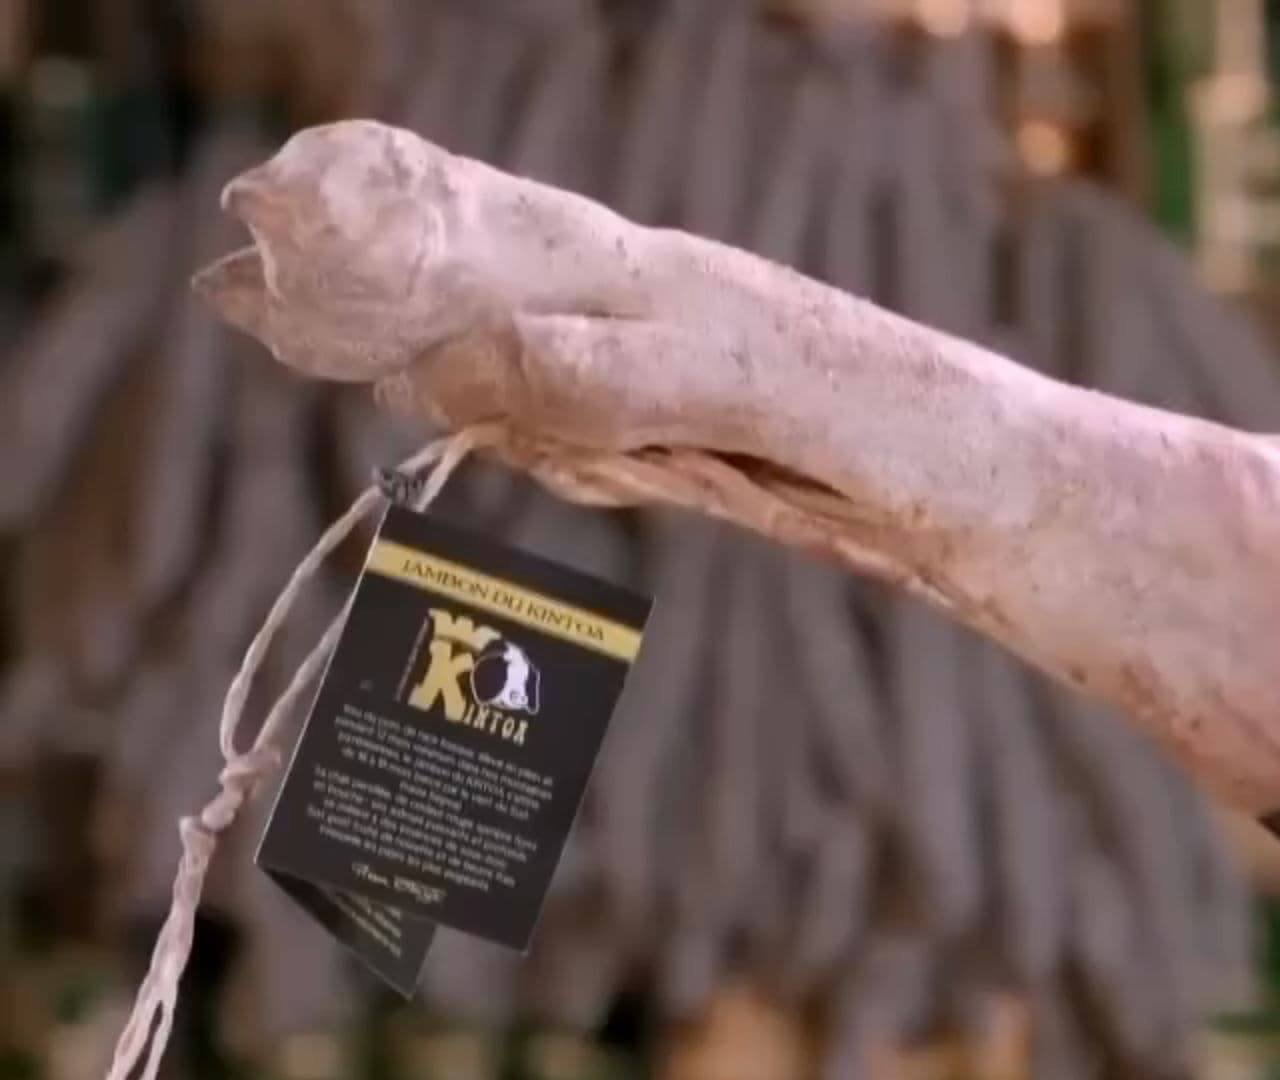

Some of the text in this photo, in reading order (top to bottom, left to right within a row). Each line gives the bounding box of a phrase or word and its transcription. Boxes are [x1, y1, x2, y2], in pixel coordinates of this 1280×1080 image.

[402, 558, 605, 641] JAMBON DU KINTOA
